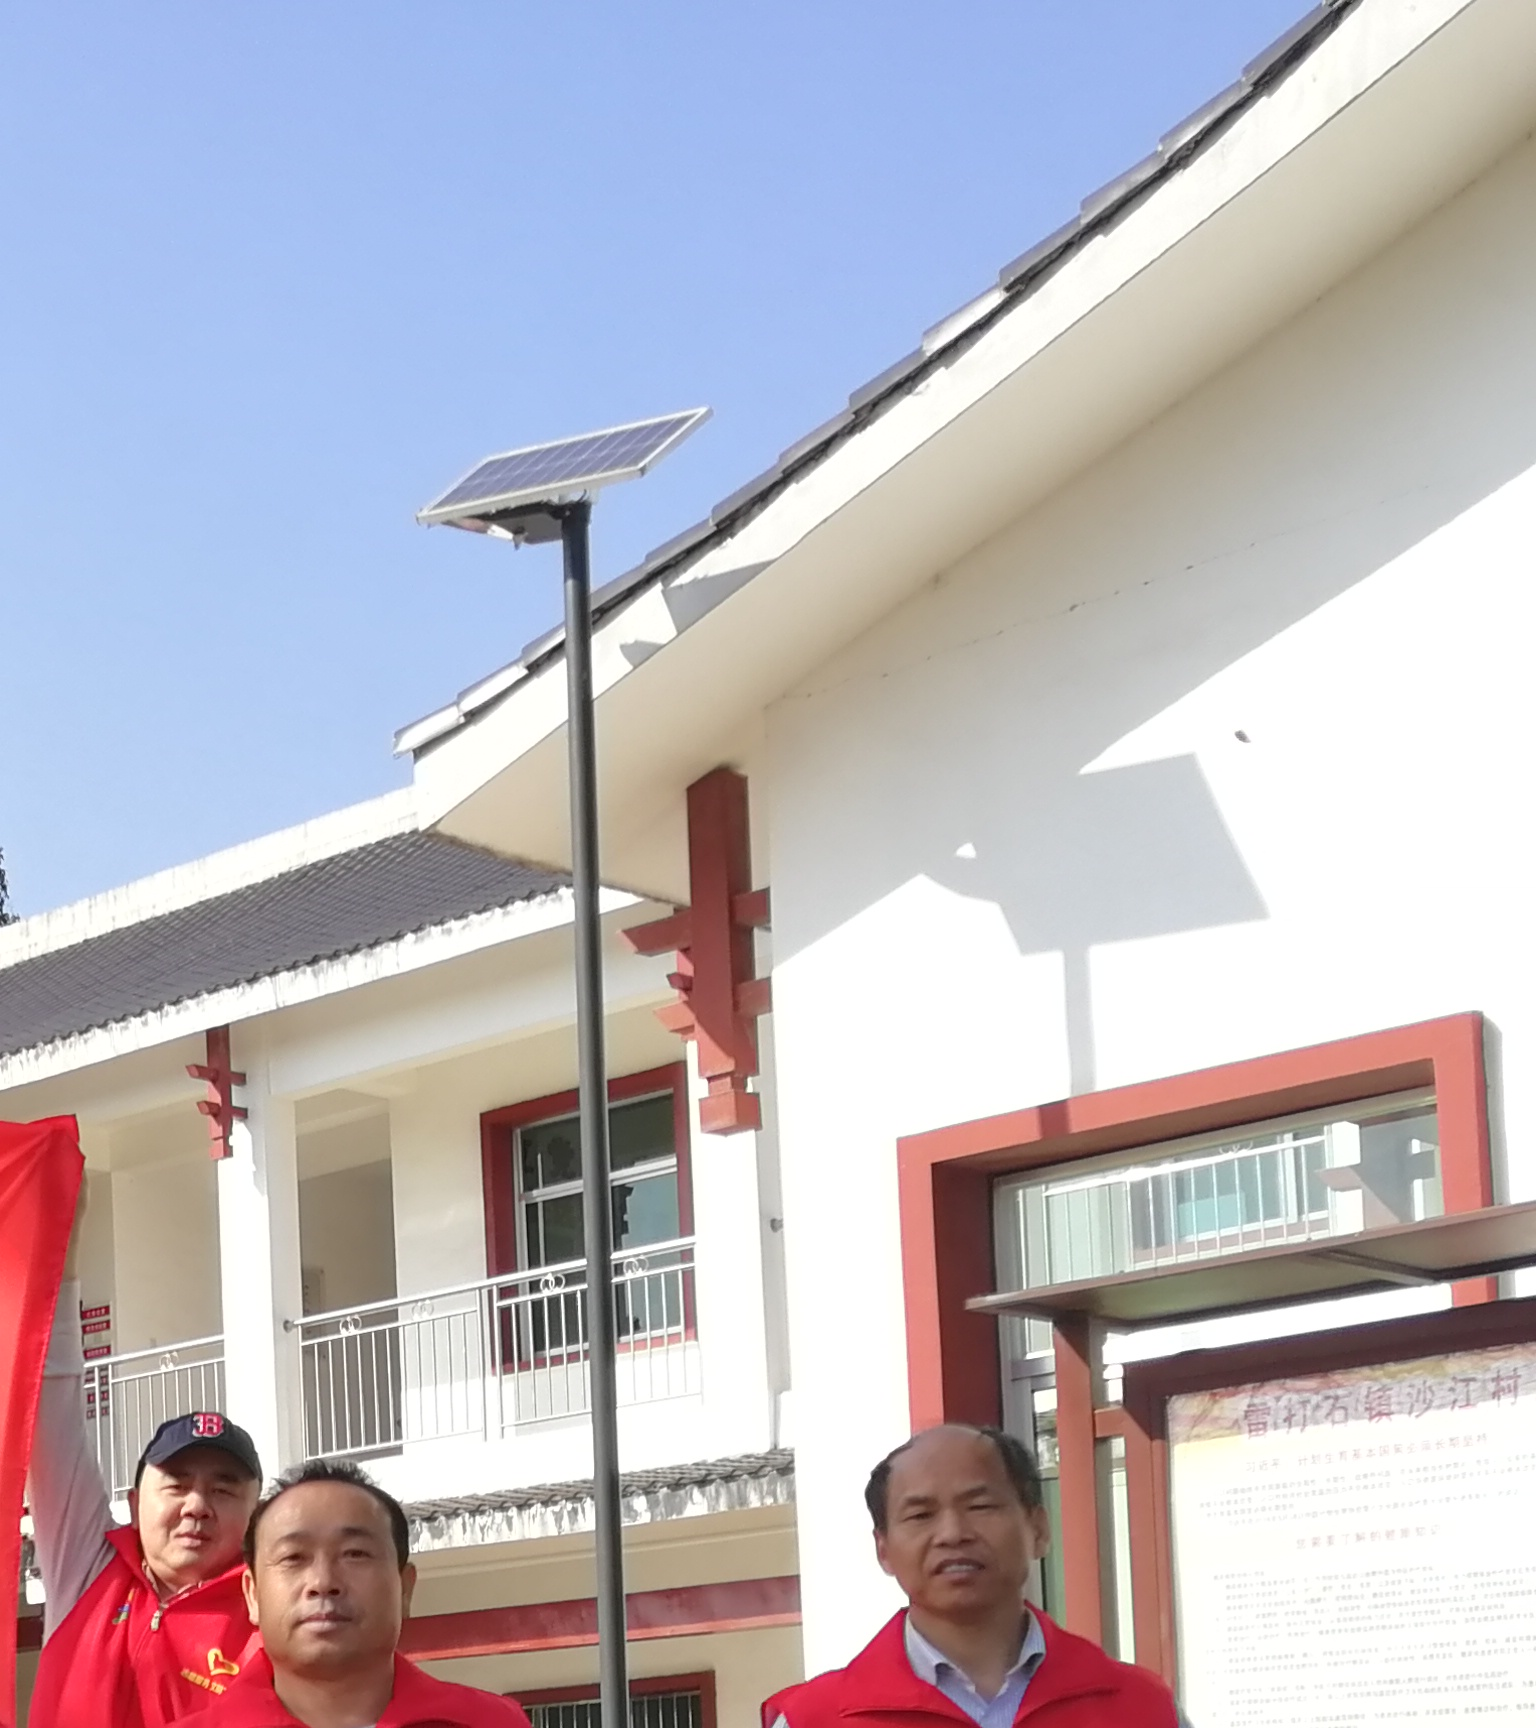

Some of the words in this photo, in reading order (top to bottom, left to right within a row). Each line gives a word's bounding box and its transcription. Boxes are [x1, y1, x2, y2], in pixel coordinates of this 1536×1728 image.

[191, 1411, 224, 1438] B
[1243, 1366, 1523, 1440] 雷打石镇沙江村
